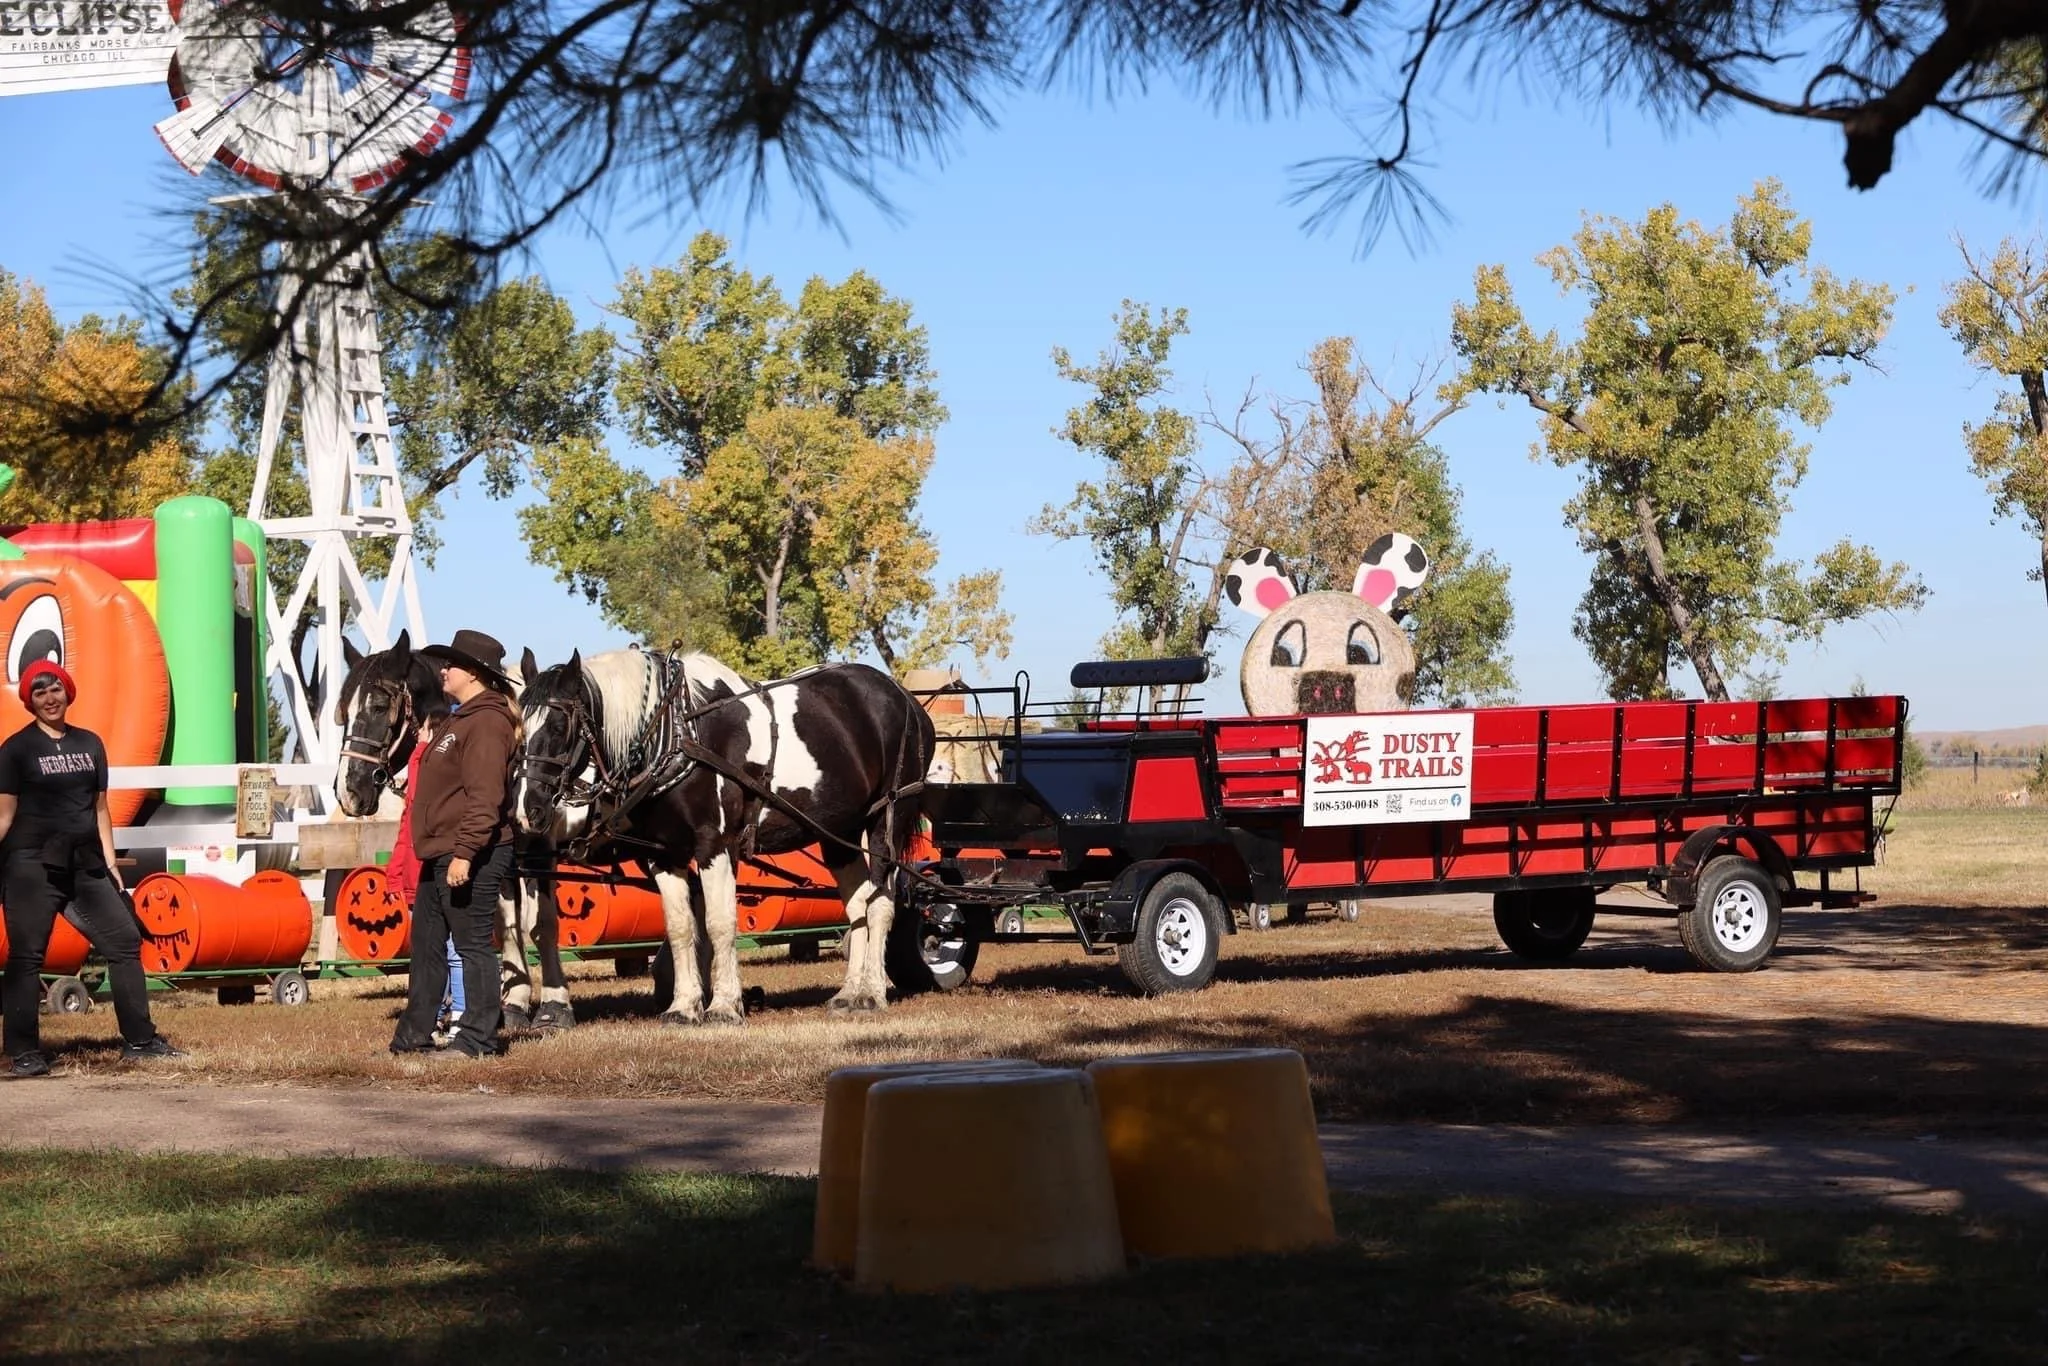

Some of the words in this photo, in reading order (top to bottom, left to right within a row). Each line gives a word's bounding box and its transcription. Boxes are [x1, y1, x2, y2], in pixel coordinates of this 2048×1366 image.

[0, 1, 166, 36] ECLIPSE
[12, 41, 81, 52] FAIRBANKS
[90, 39, 130, 48] MORSE
[43, 53, 96, 64] CHICAGO
[1382, 732, 1461, 755] DUSTY
[38, 753, 95, 775] NEBRASKA
[1379, 756, 1464, 779] TRAILS
[243, 781, 271, 789] BEWARE
[251, 792, 264, 800] THE
[1409, 797, 1427, 806] Find
[246, 802, 268, 811] FOOLS
[1312, 799, 1379, 812] 308-530-0048
[247, 812, 265, 821] GOLD
